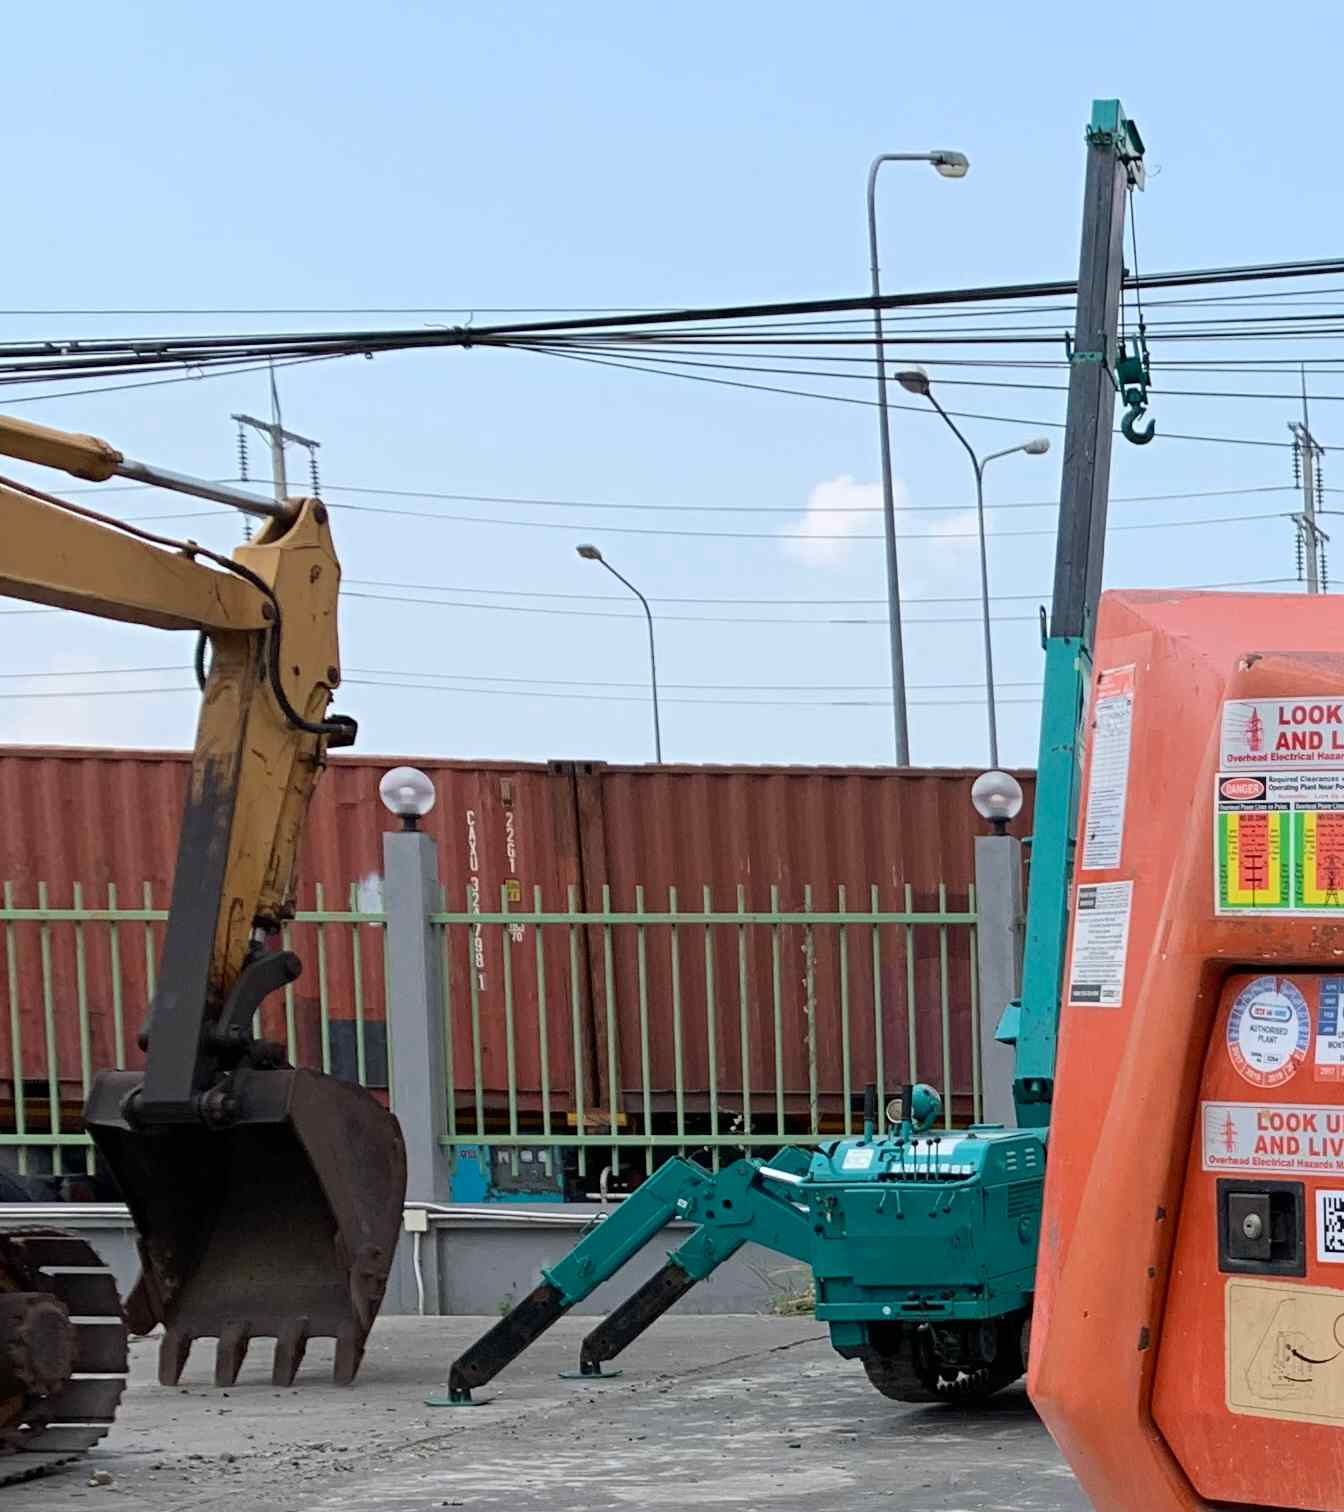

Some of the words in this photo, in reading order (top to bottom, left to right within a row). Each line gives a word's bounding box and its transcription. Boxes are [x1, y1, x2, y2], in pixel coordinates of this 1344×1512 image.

[1278, 704, 1343, 725] LOOK
[1275, 731, 1323, 751] AND
[1226, 753, 1268, 763] Overhead
[1270, 752, 1315, 762] Electrical
[471, 877, 484, 967] 32798
[1256, 1111, 1317, 1132] LOOK
[1254, 1135, 1300, 1156] AND
[1208, 1154, 1250, 1166] Overhead
[1252, 1156, 1295, 1168] Electrical
[1296, 1159, 1334, 1169] Hazards
